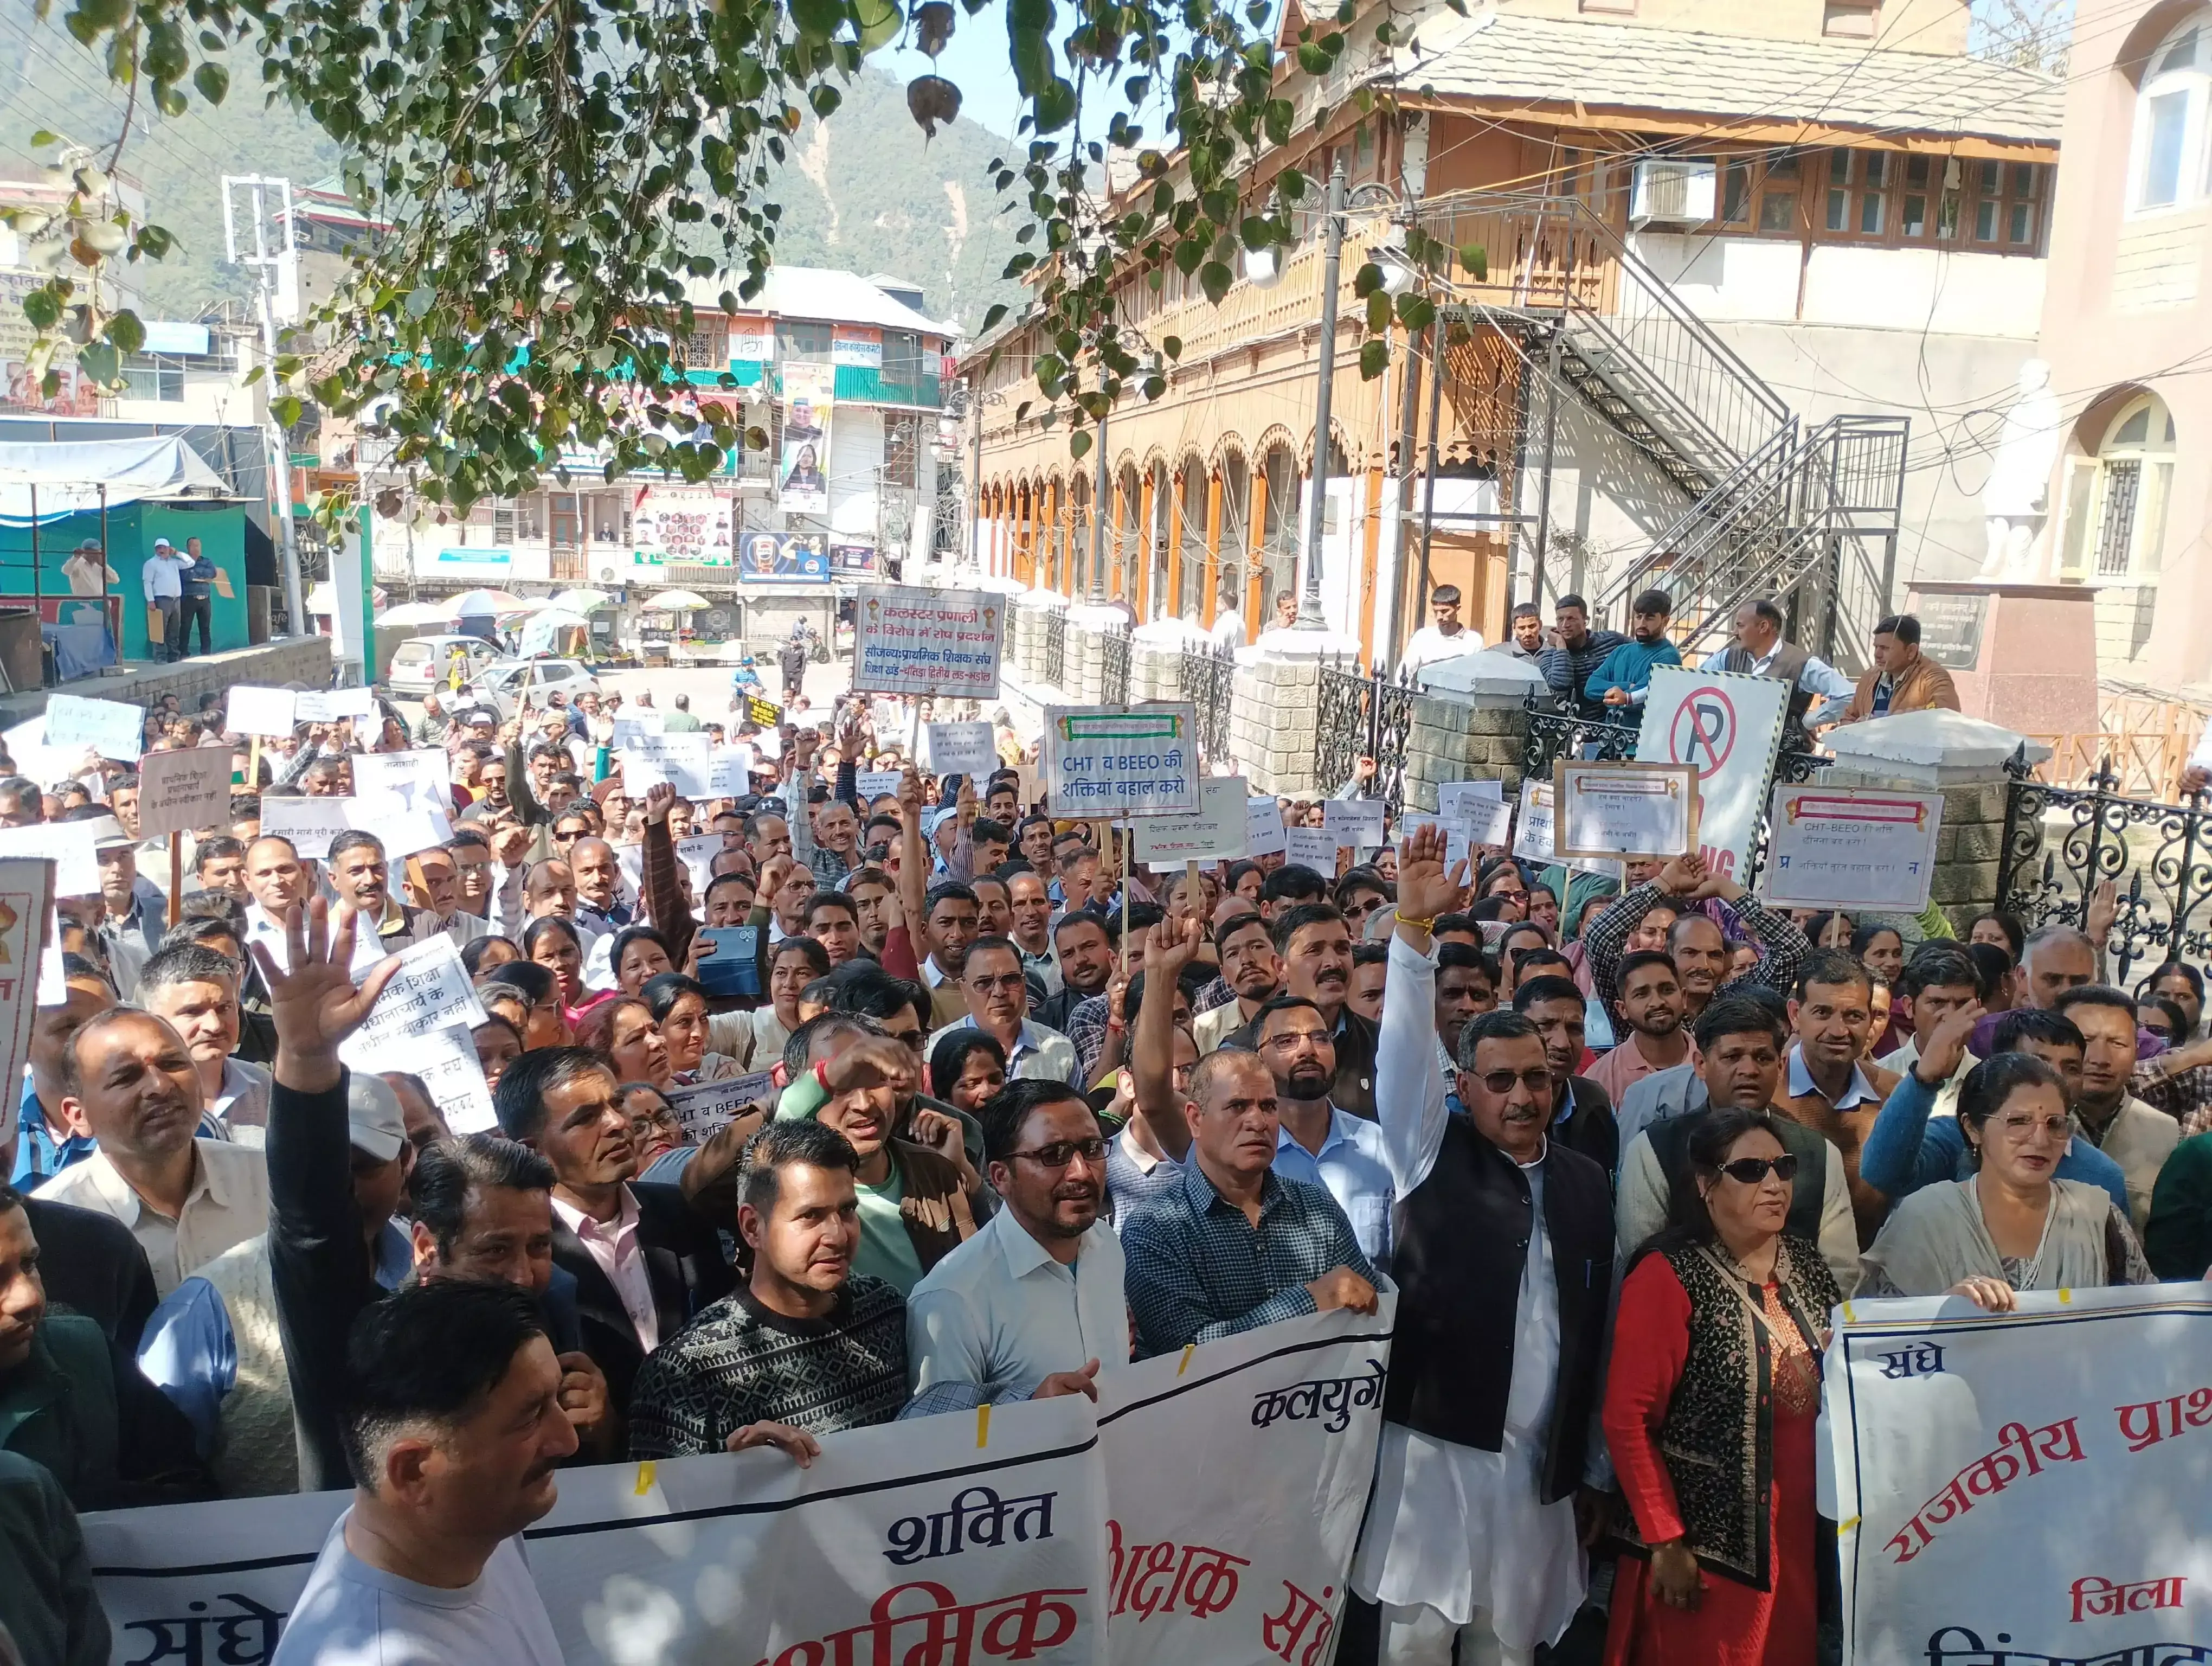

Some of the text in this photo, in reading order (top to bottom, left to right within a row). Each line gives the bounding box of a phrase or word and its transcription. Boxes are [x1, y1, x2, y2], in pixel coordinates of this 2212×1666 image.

[937, 608, 978, 623] प्रणाली
[866, 623, 995, 642] के विरोध में रोष प्रदर्शन
[943, 649, 973, 664] शिक्षक
[975, 652, 992, 665] संघ
[865, 662, 883, 675] शिक्षा
[928, 665, 949, 678] द्वितीय
[384, 758, 419, 769] तानाशाही
[1063, 749, 1183, 771] CHT व BEEO की
[1063, 775, 1185, 797] शक्तियां बहाल करो
[272, 826, 294, 836] हमारी
[314, 826, 328, 838] पूरी
[1525, 830, 1535, 843] के
[1804, 823, 1860, 833] CHT-BEEO
[406, 967, 441, 990] शिक्षा
[361, 987, 445, 1032] प्रधानाचार्य के
[395, 1010, 442, 1037] स्वीकार
[441, 996, 467, 1016] नहीं
[679, 1108, 696, 1122] HT
[701, 1106, 711, 1117] व
[681, 1128, 697, 1142] की
[1877, 1341, 1947, 1380] संघे
[1250, 1360, 1387, 1433] कलयुगे
[1883, 1416, 2088, 1564] राजकीय
[883, 1486, 1058, 1565] शक्ति
[2068, 1576, 2188, 1623] जिला
[124, 1593, 288, 1666] संघे
